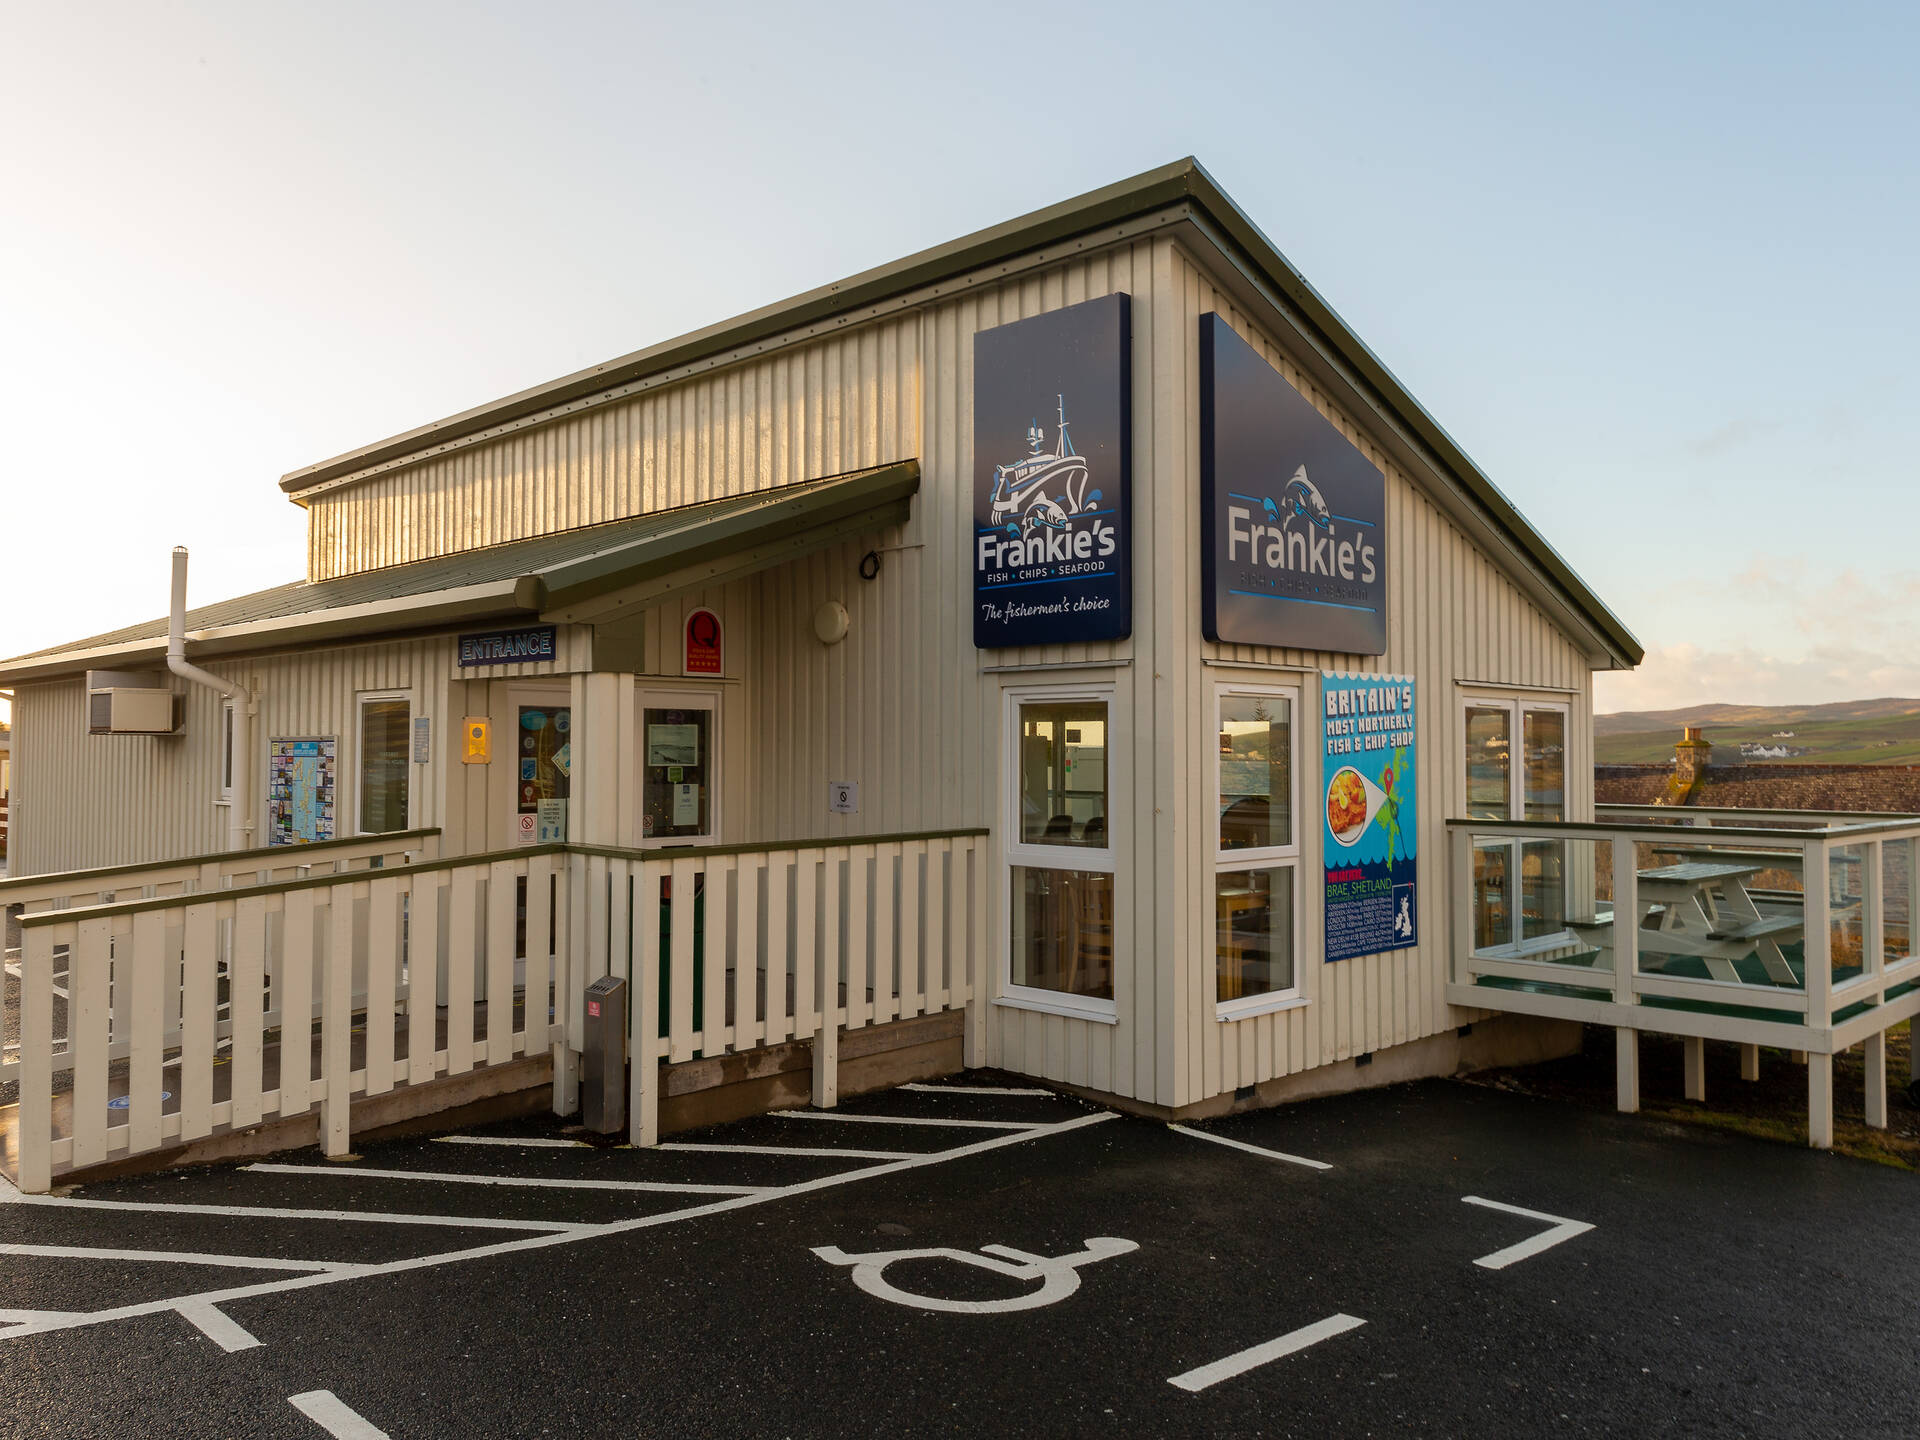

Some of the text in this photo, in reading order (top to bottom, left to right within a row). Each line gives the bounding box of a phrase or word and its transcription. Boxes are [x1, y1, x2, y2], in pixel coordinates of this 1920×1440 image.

[978, 519, 1115, 571] Frankie's
[1228, 505, 1376, 583] Frankie's
[987, 560, 1106, 583] FISH CHIPS SEAFOOD
[981, 596, 1110, 625] The fishermen's choice
[462, 631, 551, 661] ENTRANCE
[1326, 686, 1412, 717] BRITAIN'S
[1326, 714, 1413, 737] MOST NORTHERLY
[1327, 731, 1414, 756] FISH & CHIP SHOP
[1351, 878, 1392, 895] SHETLAND
